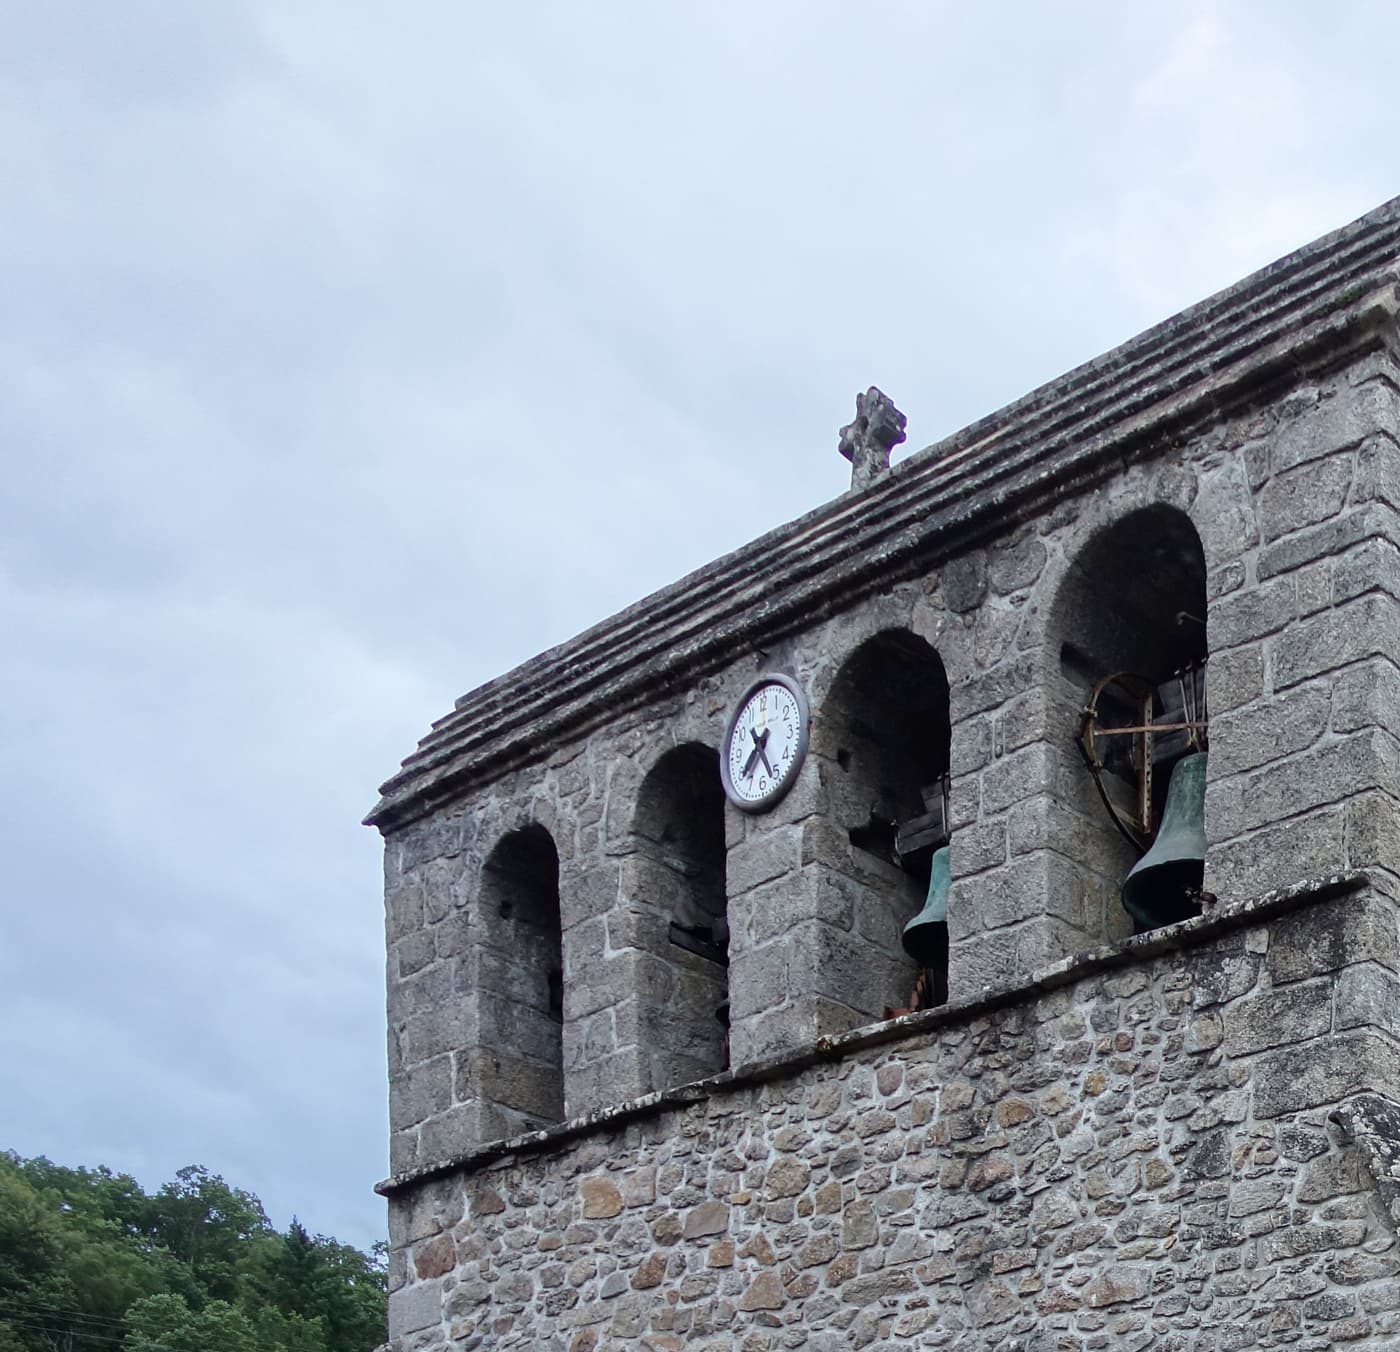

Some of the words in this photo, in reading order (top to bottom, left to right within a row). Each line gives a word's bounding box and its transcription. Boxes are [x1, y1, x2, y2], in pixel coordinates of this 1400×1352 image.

[760, 695, 767, 712] 12
[775, 695, 778, 710] 1
[749, 707, 755, 723] 11
[782, 705, 790, 721] 2
[738, 726, 746, 743] 10
[786, 724, 794, 740] 3
[736, 748, 742, 763] 9
[782, 745, 789, 760] 4
[738, 766, 745, 781] 8
[772, 764, 780, 780] 5
[747, 775, 754, 791] 7
[759, 775, 767, 790] 6
